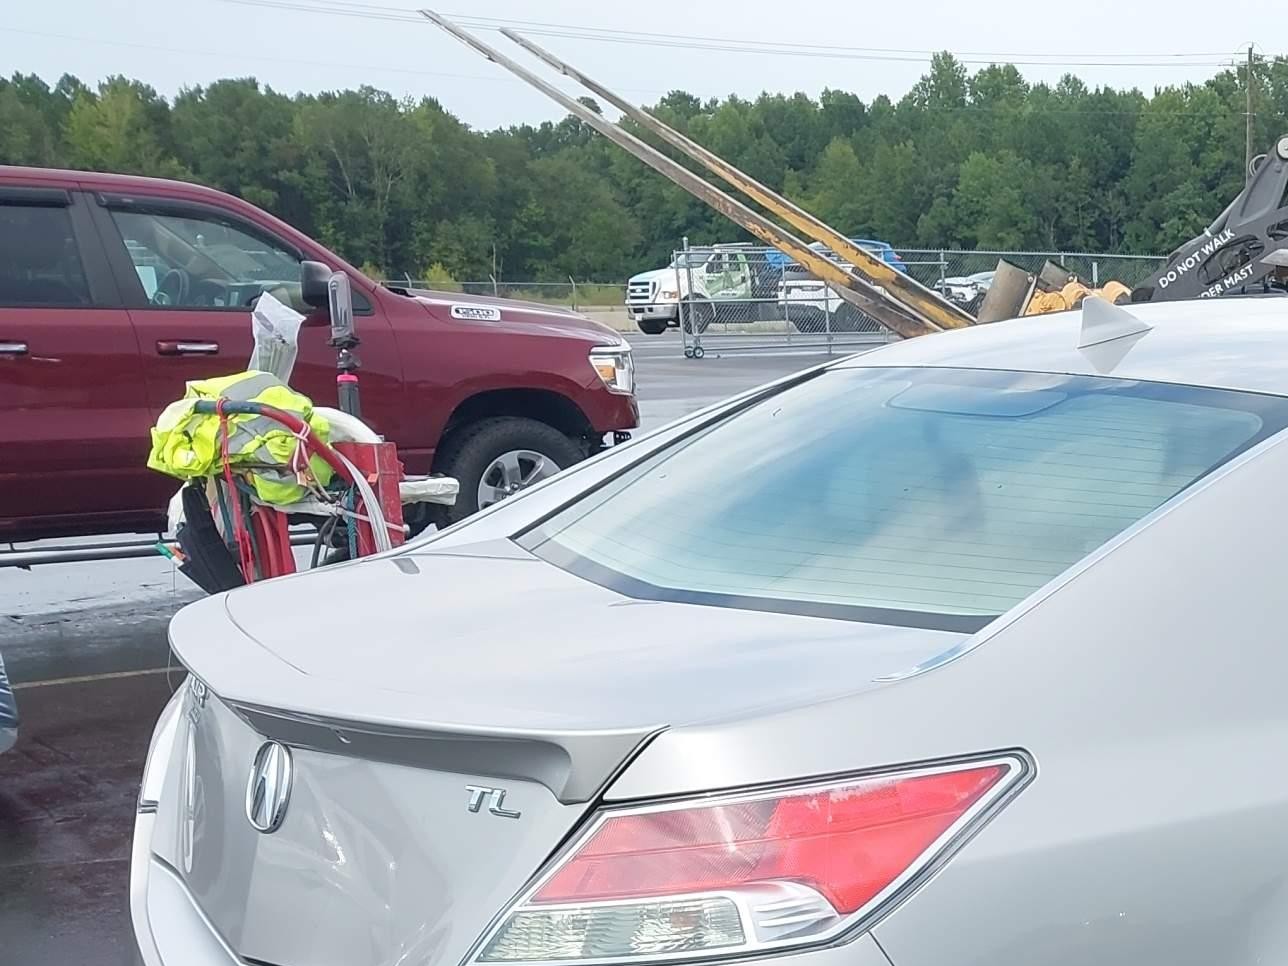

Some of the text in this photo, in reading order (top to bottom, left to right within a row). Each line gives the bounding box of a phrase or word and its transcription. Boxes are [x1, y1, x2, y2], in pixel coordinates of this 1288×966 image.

[1158, 228, 1236, 288] DO NOT WALK
[1223, 264, 1254, 288] MAST
[465, 784, 521, 819] TL
